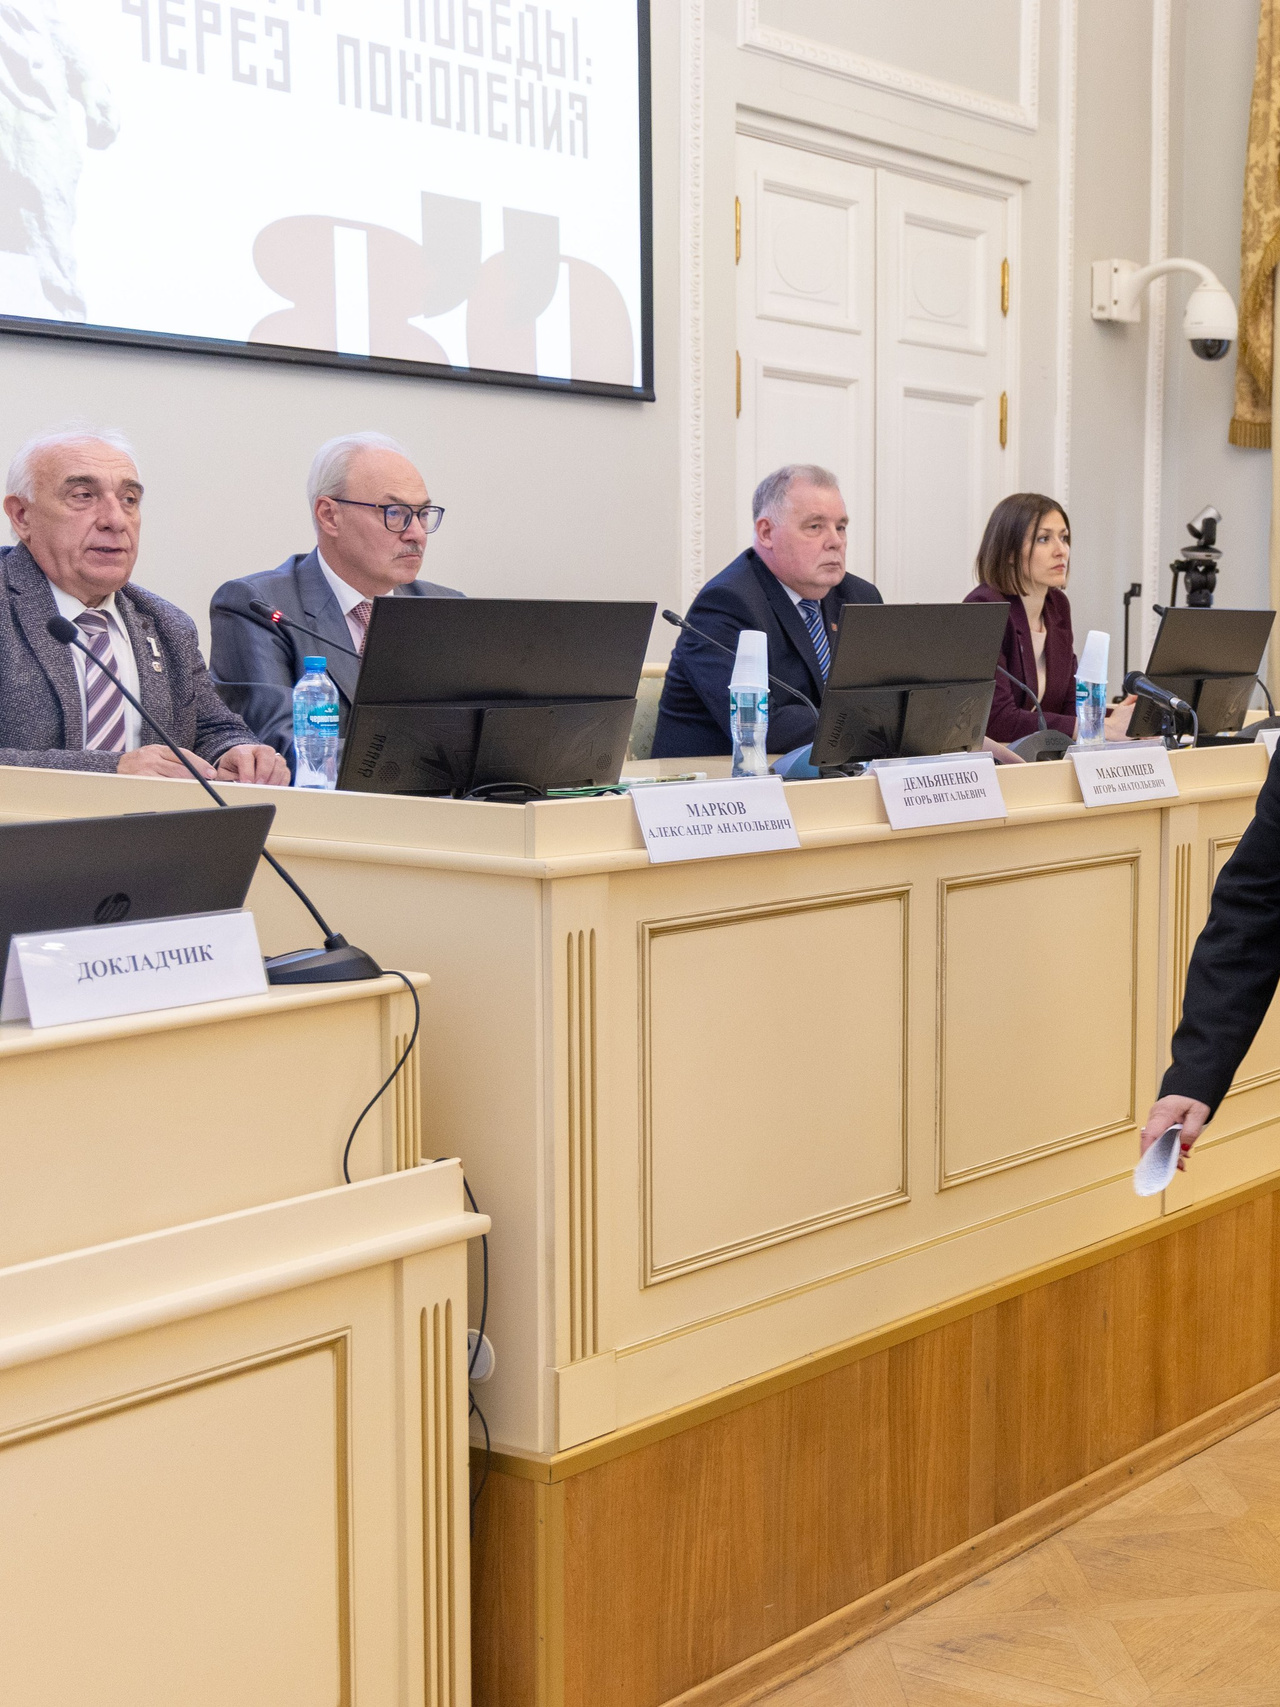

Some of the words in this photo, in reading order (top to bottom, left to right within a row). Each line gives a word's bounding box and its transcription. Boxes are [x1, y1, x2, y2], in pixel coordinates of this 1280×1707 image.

[122, 0, 291, 93] ЧЕРЕЗ
[337, 33, 588, 159] ПОКОЛЕНИЯ
[1045, 737, 1067, 746] BOSCH
[902, 770, 979, 792] ДЕМЬЯНЕНКО
[1095, 763, 1155, 780] МАКСИМЦЕВ
[1093, 784, 1117, 795] ИГОРЬ
[1117, 779, 1166, 792] АНАТОЛЬЕВИЧ
[903, 794, 932, 807] ИГОРЬ
[933, 788, 987, 804] ВИТАЛЬЕВИЧ
[685, 801, 747, 818] МАРКОВ
[648, 824, 713, 839] АЛЕКСАНДР
[716, 818, 792, 834] АНАТОЛЬЕВИЧ
[77, 944, 214, 984] ДОКЛАДЧИК
